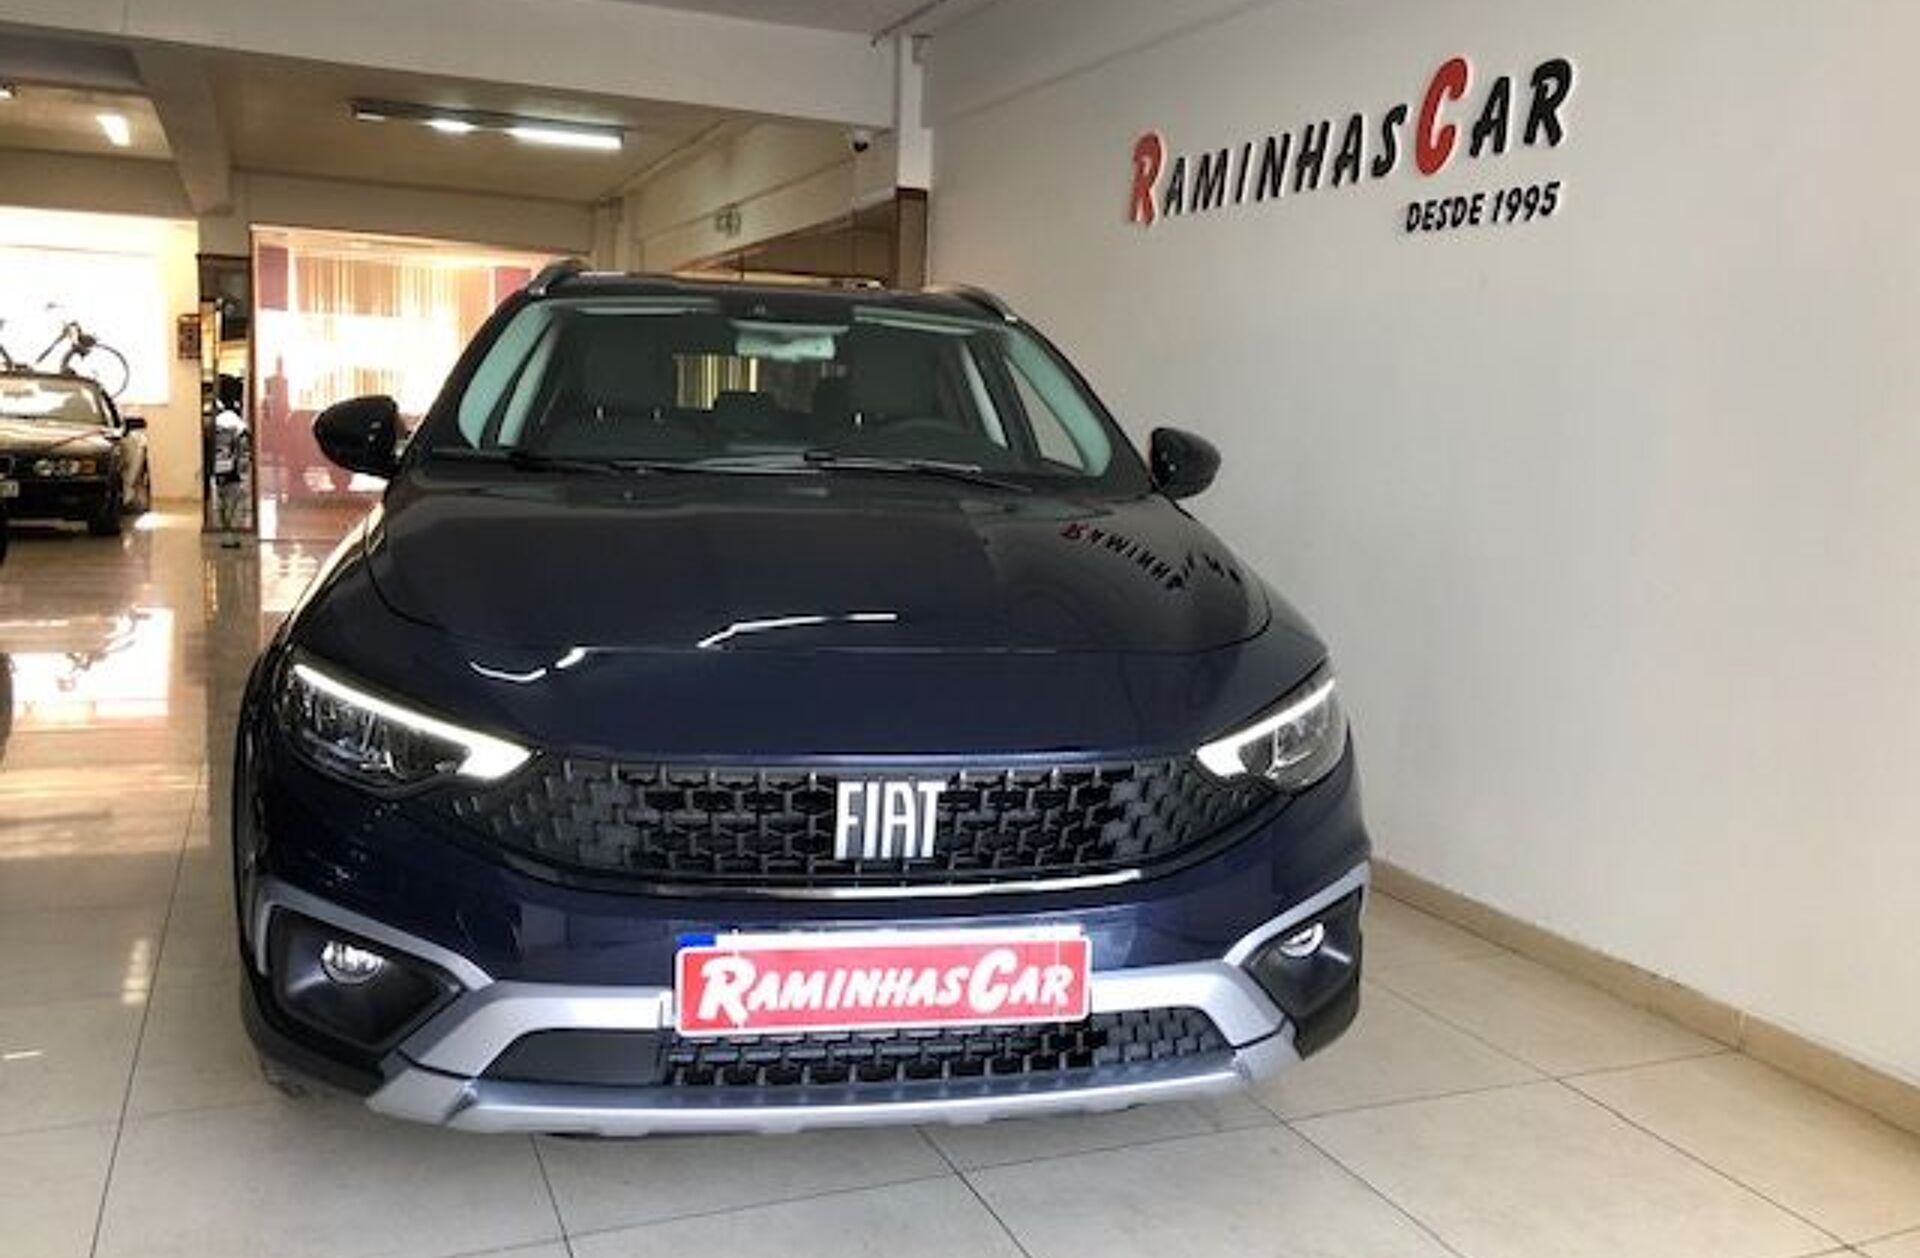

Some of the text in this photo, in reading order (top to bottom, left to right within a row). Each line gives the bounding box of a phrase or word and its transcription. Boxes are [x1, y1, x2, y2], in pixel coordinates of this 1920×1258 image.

[1406, 181, 1561, 233] DESDE 1995
[834, 780, 947, 860] FIAT
